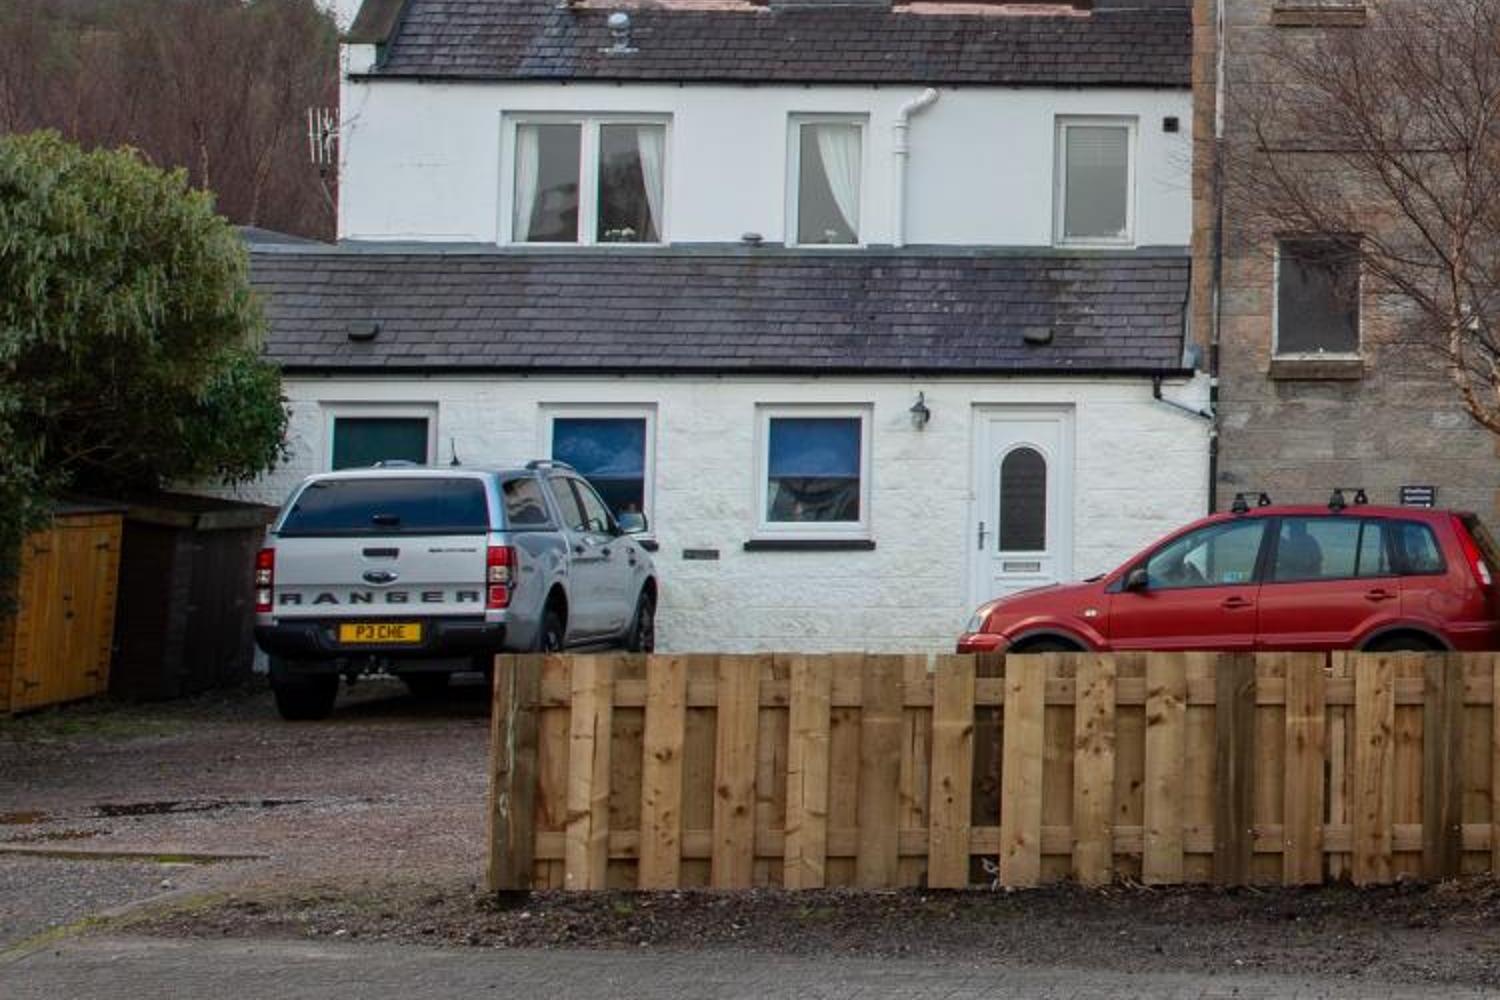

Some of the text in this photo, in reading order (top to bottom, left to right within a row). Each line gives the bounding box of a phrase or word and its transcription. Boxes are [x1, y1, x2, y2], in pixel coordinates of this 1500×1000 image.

[279, 591, 480, 605] RANGER
[355, 624, 406, 639] P3 CHE
